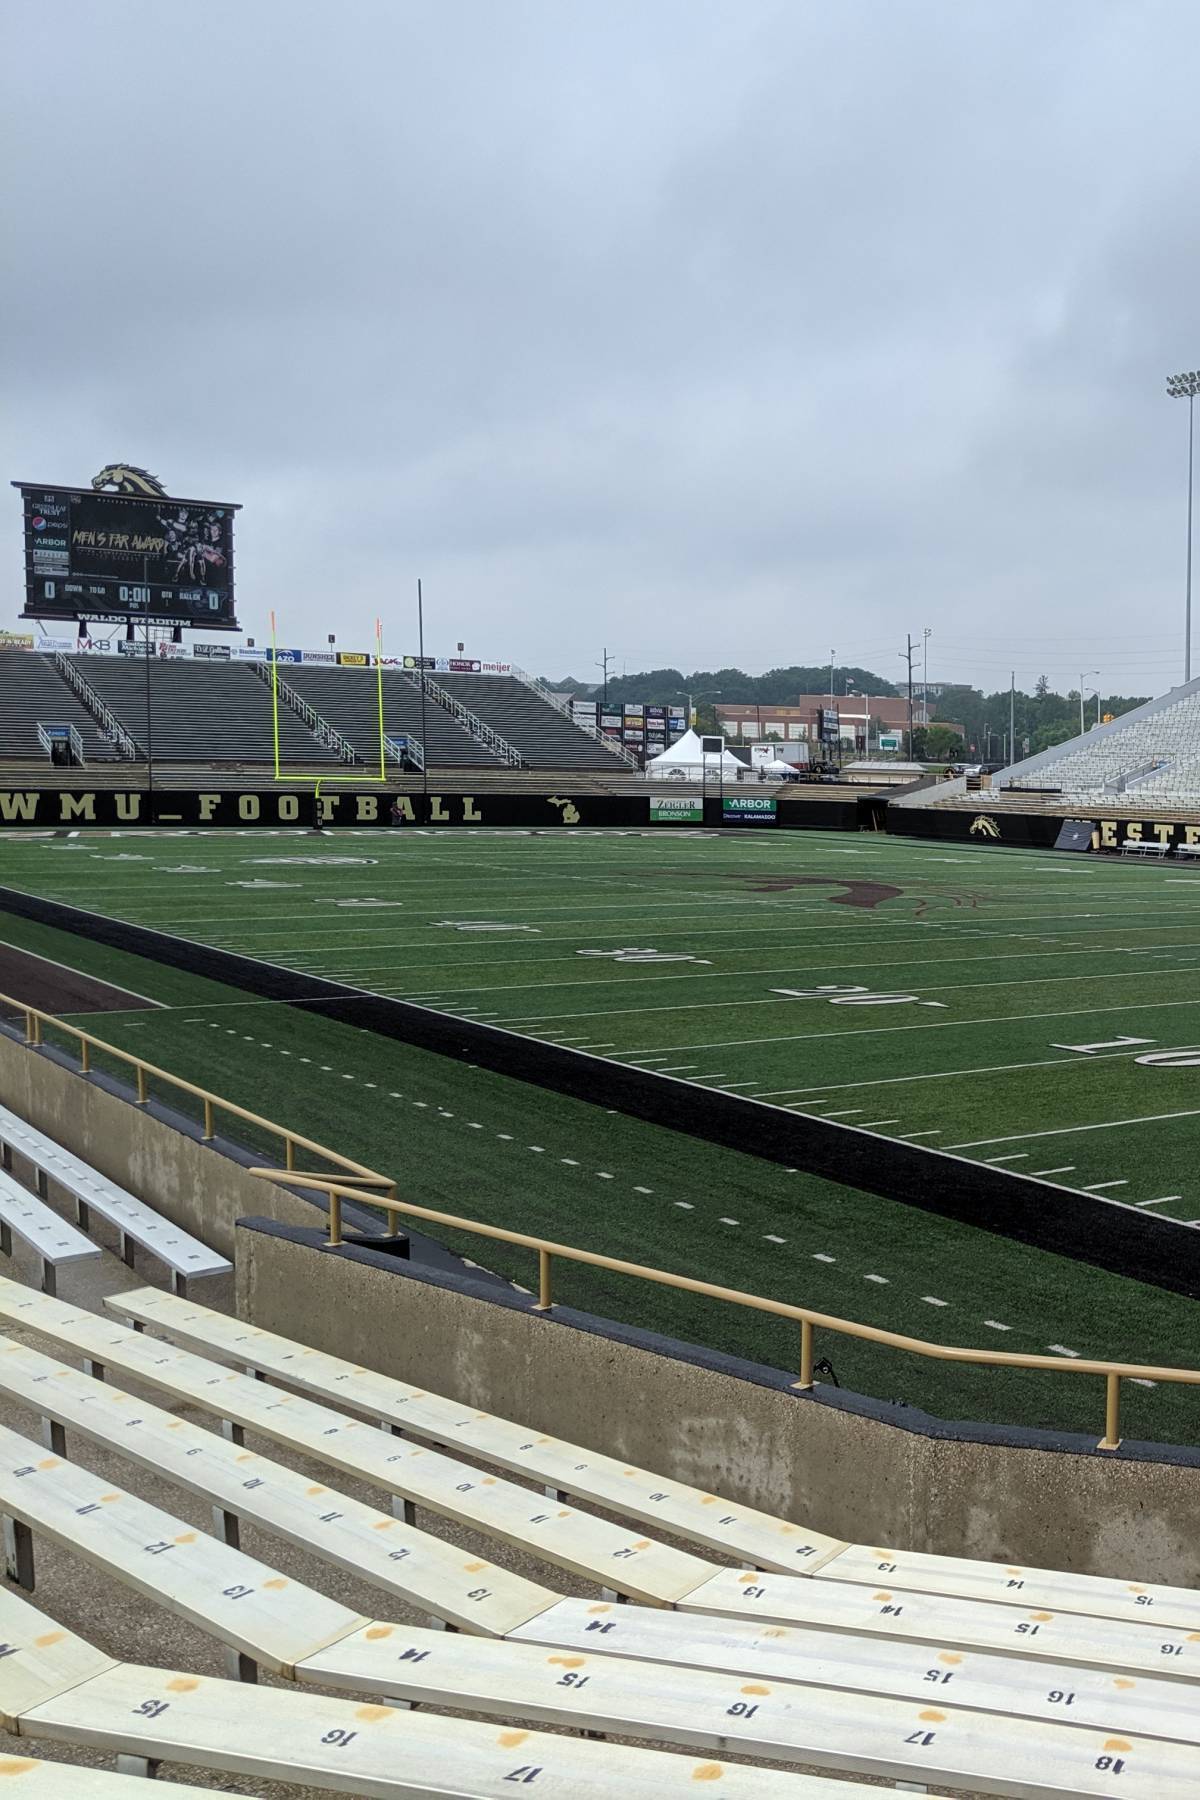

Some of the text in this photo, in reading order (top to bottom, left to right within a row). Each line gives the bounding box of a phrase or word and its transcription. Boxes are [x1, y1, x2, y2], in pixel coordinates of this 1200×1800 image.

[34, 537, 66, 547] ARBOR
[119, 586, 151, 603] 0:00
[77, 612, 192, 627] WALDO STADIUM
[77, 638, 111, 651] MKB
[482, 663, 511, 673] meijer
[729, 799, 771, 808] ARBOR
[12, 1466, 38, 1478] 10
[241, 1478, 265, 1490] 10
[455, 1483, 476, 1493] 10
[648, 1493, 670, 1502] 10
[143, 1541, 176, 1555] 12
[387, 1548, 411, 1561] 12
[612, 1548, 638, 1559] 12
[795, 1545, 817, 1557] 12
[877, 1562, 897, 1573] 13
[1006, 1579, 1025, 1590] 14
[221, 1585, 255, 1600] 13
[466, 1588, 493, 1602] 13
[742, 1586, 766, 1599] 13
[1134, 1595, 1154, 1606] 15
[879, 1604, 904, 1617] 14
[584, 1620, 617, 1634] 14
[1014, 1623, 1040, 1636] 15
[398, 1648, 431, 1663] 14
[1160, 1644, 1183, 1656] 16
[556, 1672, 590, 1689] 15
[923, 1669, 954, 1684] 15
[1047, 1690, 1076, 1706] 16
[131, 1699, 170, 1719] 15
[726, 1702, 759, 1719] 16
[320, 1729, 358, 1748] 16
[903, 1730, 936, 1746] 17
[1094, 1755, 1125, 1775] 18
[502, 1766, 543, 1784] 17
